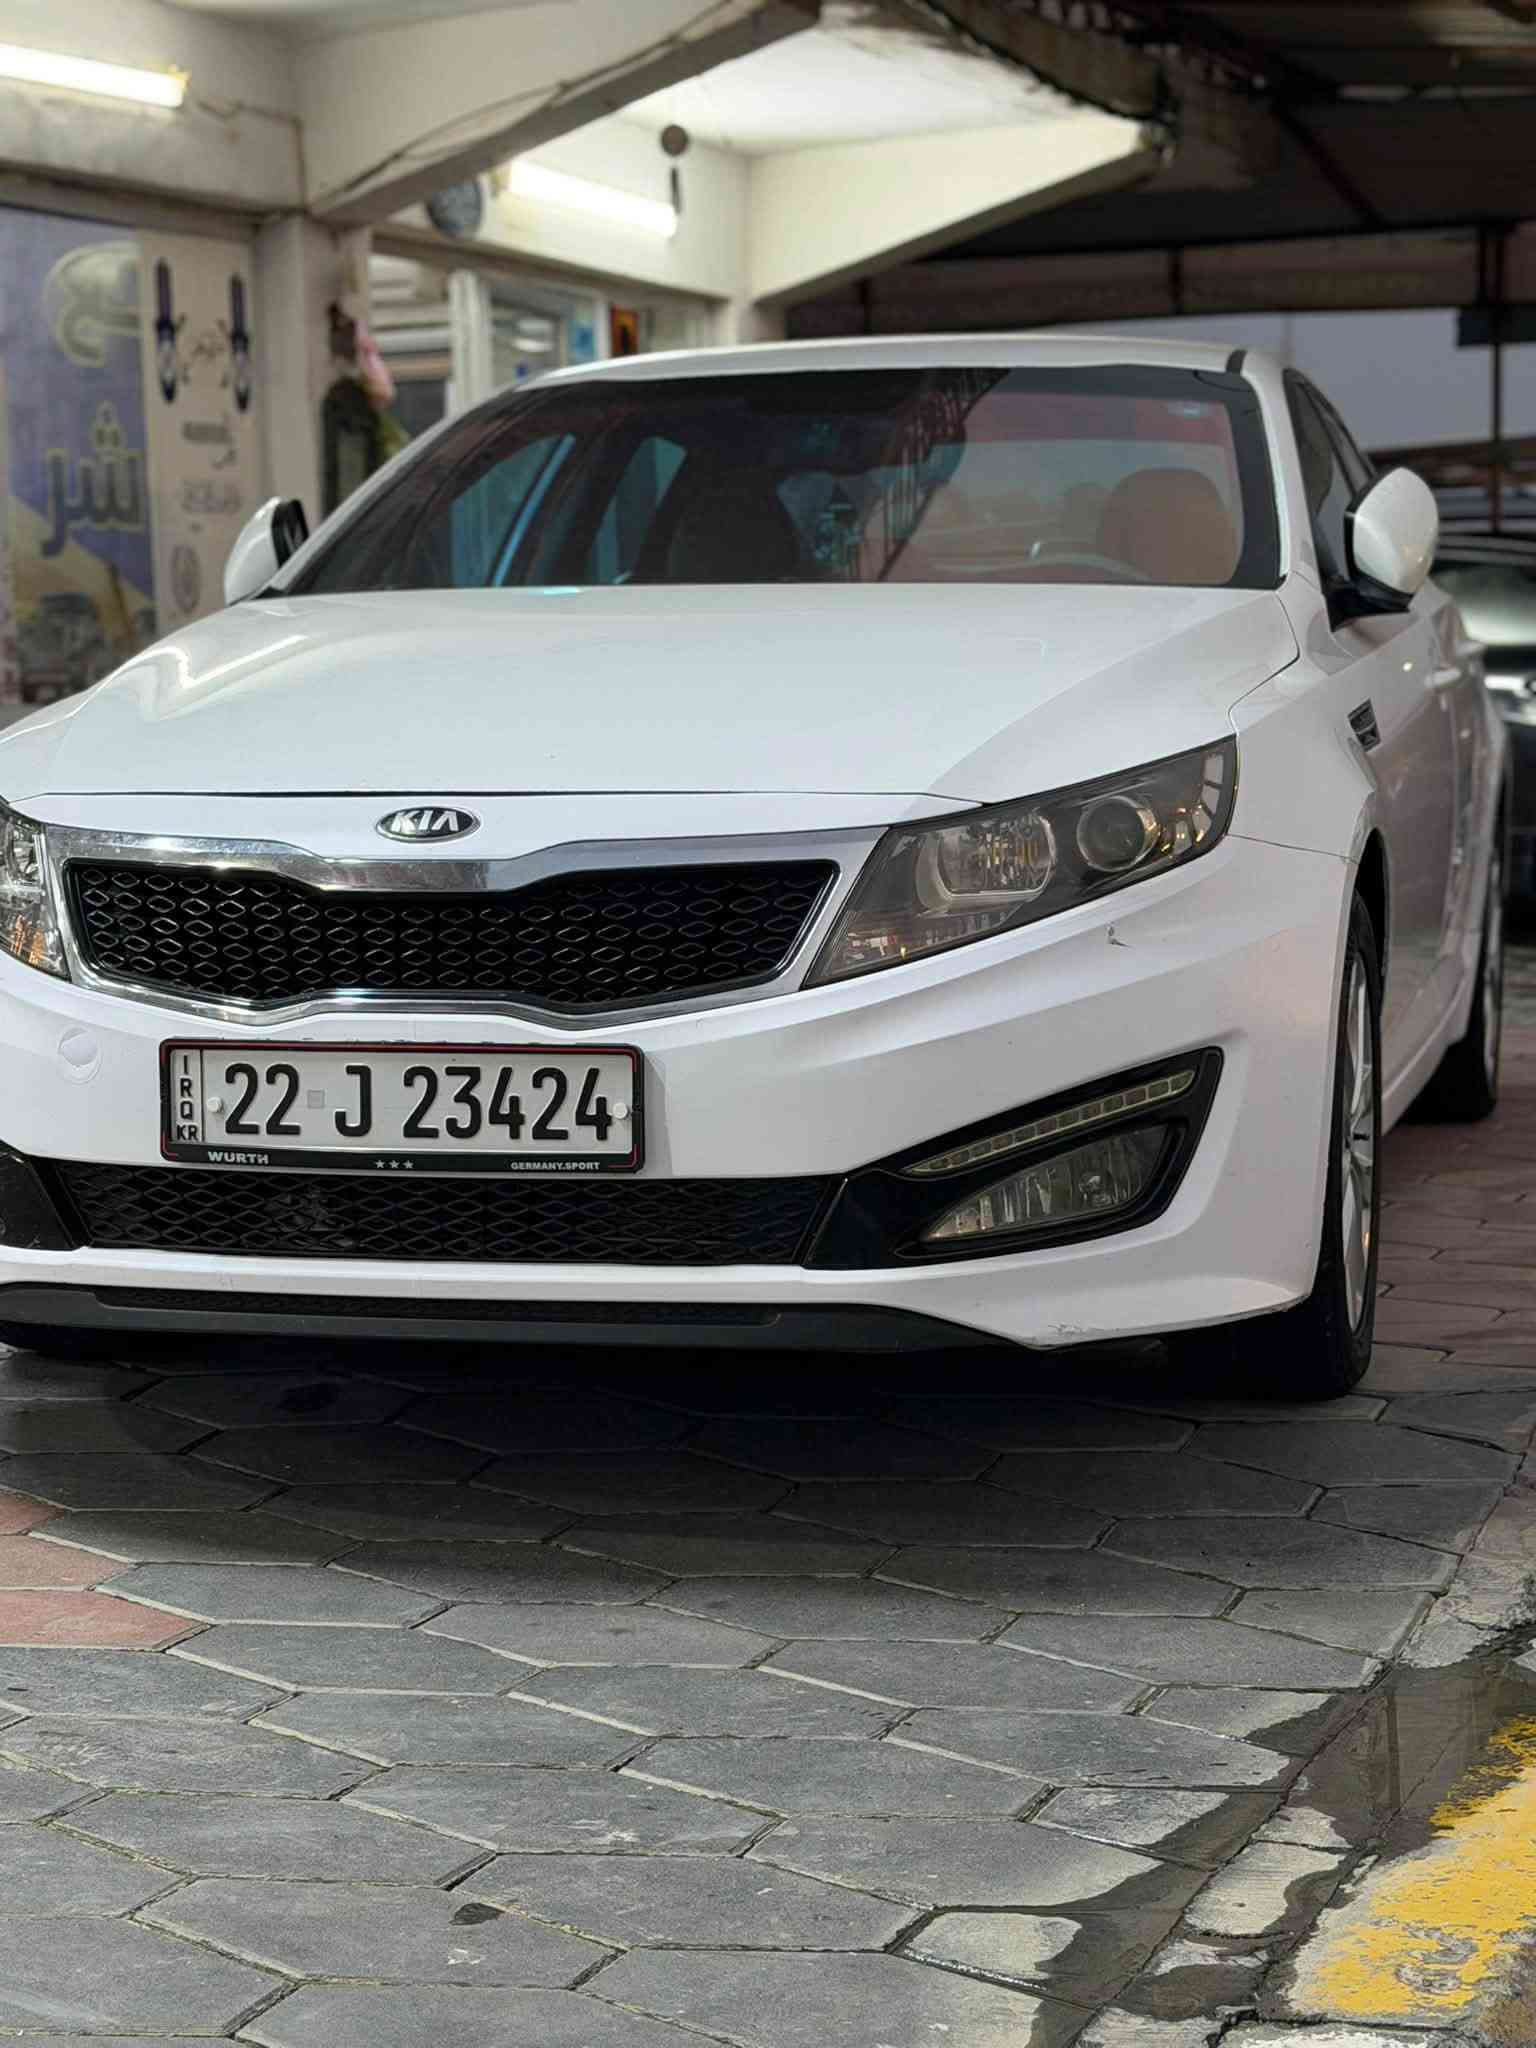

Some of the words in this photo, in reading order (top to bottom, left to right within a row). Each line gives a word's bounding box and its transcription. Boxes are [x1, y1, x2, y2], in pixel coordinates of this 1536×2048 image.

[390, 809, 459, 833] KIA
[224, 1062, 302, 1136] 22
[333, 1064, 373, 1138] J
[402, 1066, 613, 1141] 23424
[176, 1124, 199, 1141] KR
[207, 1151, 270, 1165] WURTH
[510, 1161, 601, 1171] GERMANY.SPORT
